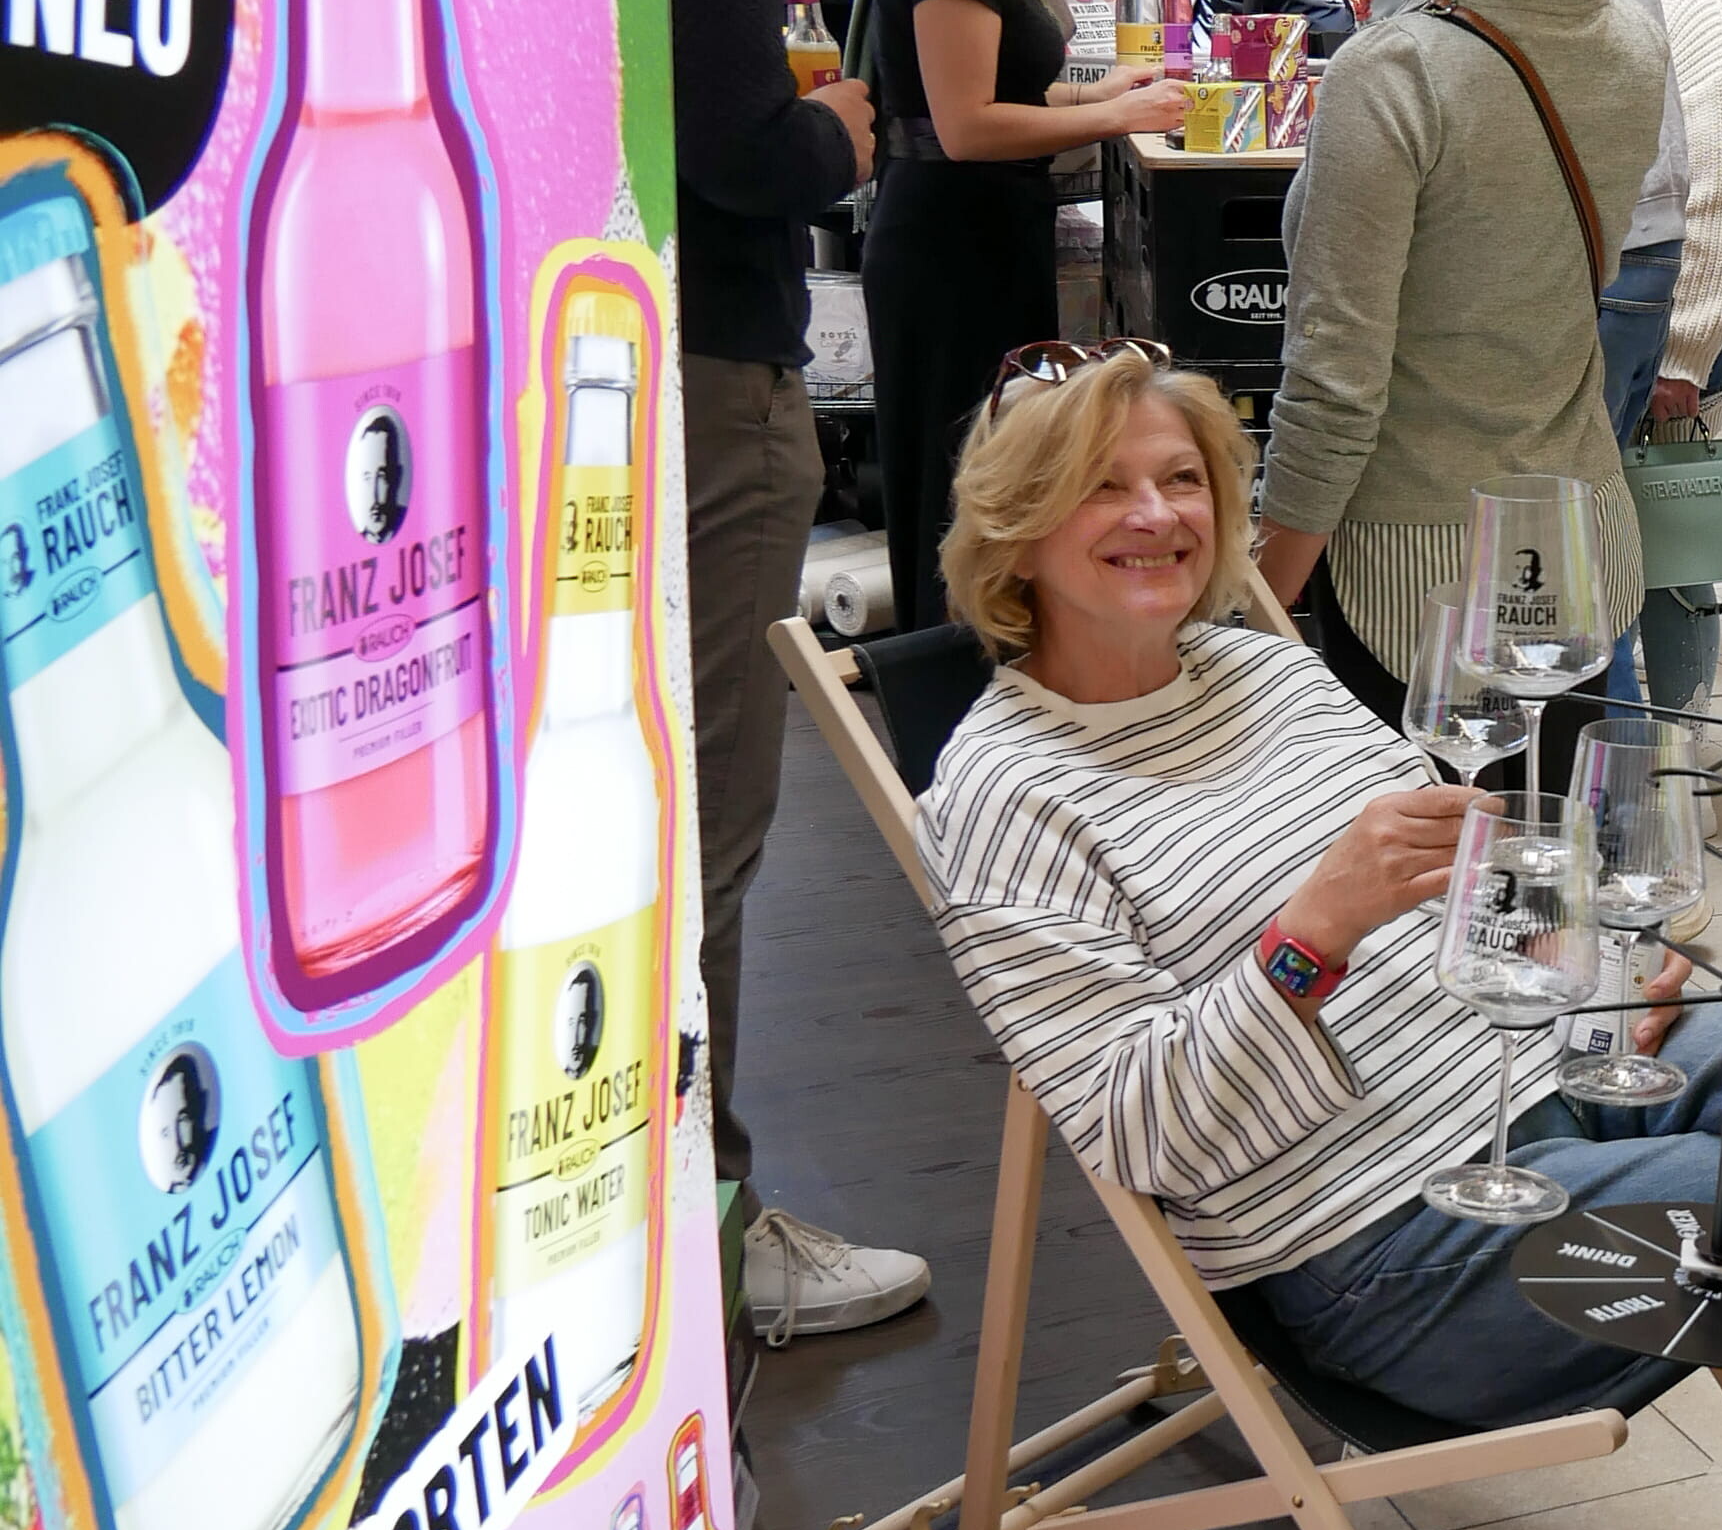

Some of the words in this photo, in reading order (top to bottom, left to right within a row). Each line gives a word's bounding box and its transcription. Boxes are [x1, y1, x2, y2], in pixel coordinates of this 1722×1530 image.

[1070, 67, 1106, 83] FRANZ
[36, 478, 80, 524] FRANZ
[85, 449, 123, 493] JOSEF
[42, 477, 134, 575] RAUCH
[585, 516, 632, 553] RAUCH
[288, 557, 380, 637] FRANZ
[388, 525, 466, 605] JOSEF
[1497, 593, 1527, 606] FRANZ
[1529, 594, 1558, 606] JOSEF
[367, 621, 411, 654] RAUCH
[1496, 605, 1558, 627] RAUCH
[290, 688, 348, 741] EXOTIC
[354, 632, 472, 720] DRAGONFRUIT
[1466, 923, 1529, 953] RAUCH
[507, 1090, 575, 1162] FRANZ
[583, 1060, 643, 1131] JOSEF
[564, 1147, 596, 1171] RAUCH
[88, 1202, 202, 1355] FRANZ
[211, 1091, 298, 1230] JOSEF
[524, 1185, 571, 1244] TONIC
[577, 1164, 625, 1220] WATER
[192, 1235, 242, 1294] RAUCH
[1557, 1242, 1639, 1270] DRINK
[135, 1310, 224, 1425] BITTER
[226, 1212, 301, 1324] LEMON
[1584, 1293, 1666, 1323] TRUTH
